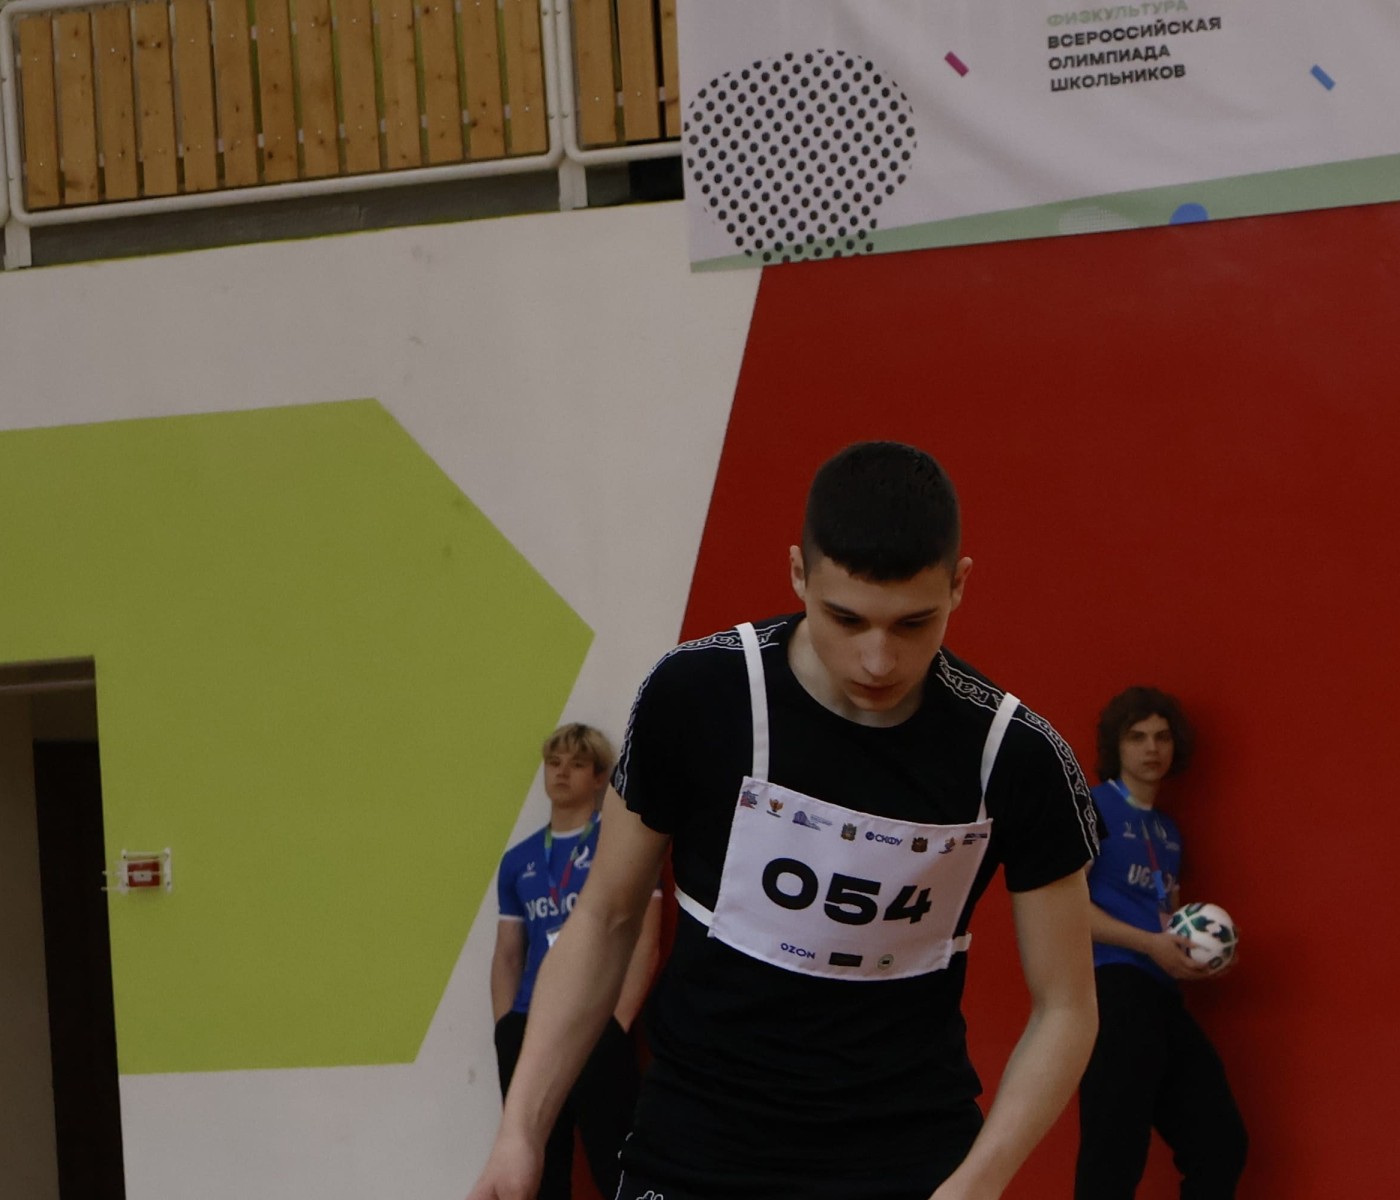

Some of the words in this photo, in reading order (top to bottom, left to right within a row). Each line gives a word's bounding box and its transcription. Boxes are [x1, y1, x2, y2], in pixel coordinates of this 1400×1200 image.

[1047, 0, 1188, 27] ФИЗКУЛЬТУРА
[1048, 16, 1222, 49] ВСЕРОССИЙСКАЯ
[1048, 44, 1171, 70] ОЛИМПИАДА
[1050, 64, 1186, 93] ШКОЛЬНИКОВ
[761, 857, 933, 926] 054
[780, 942, 816, 960] OZON
